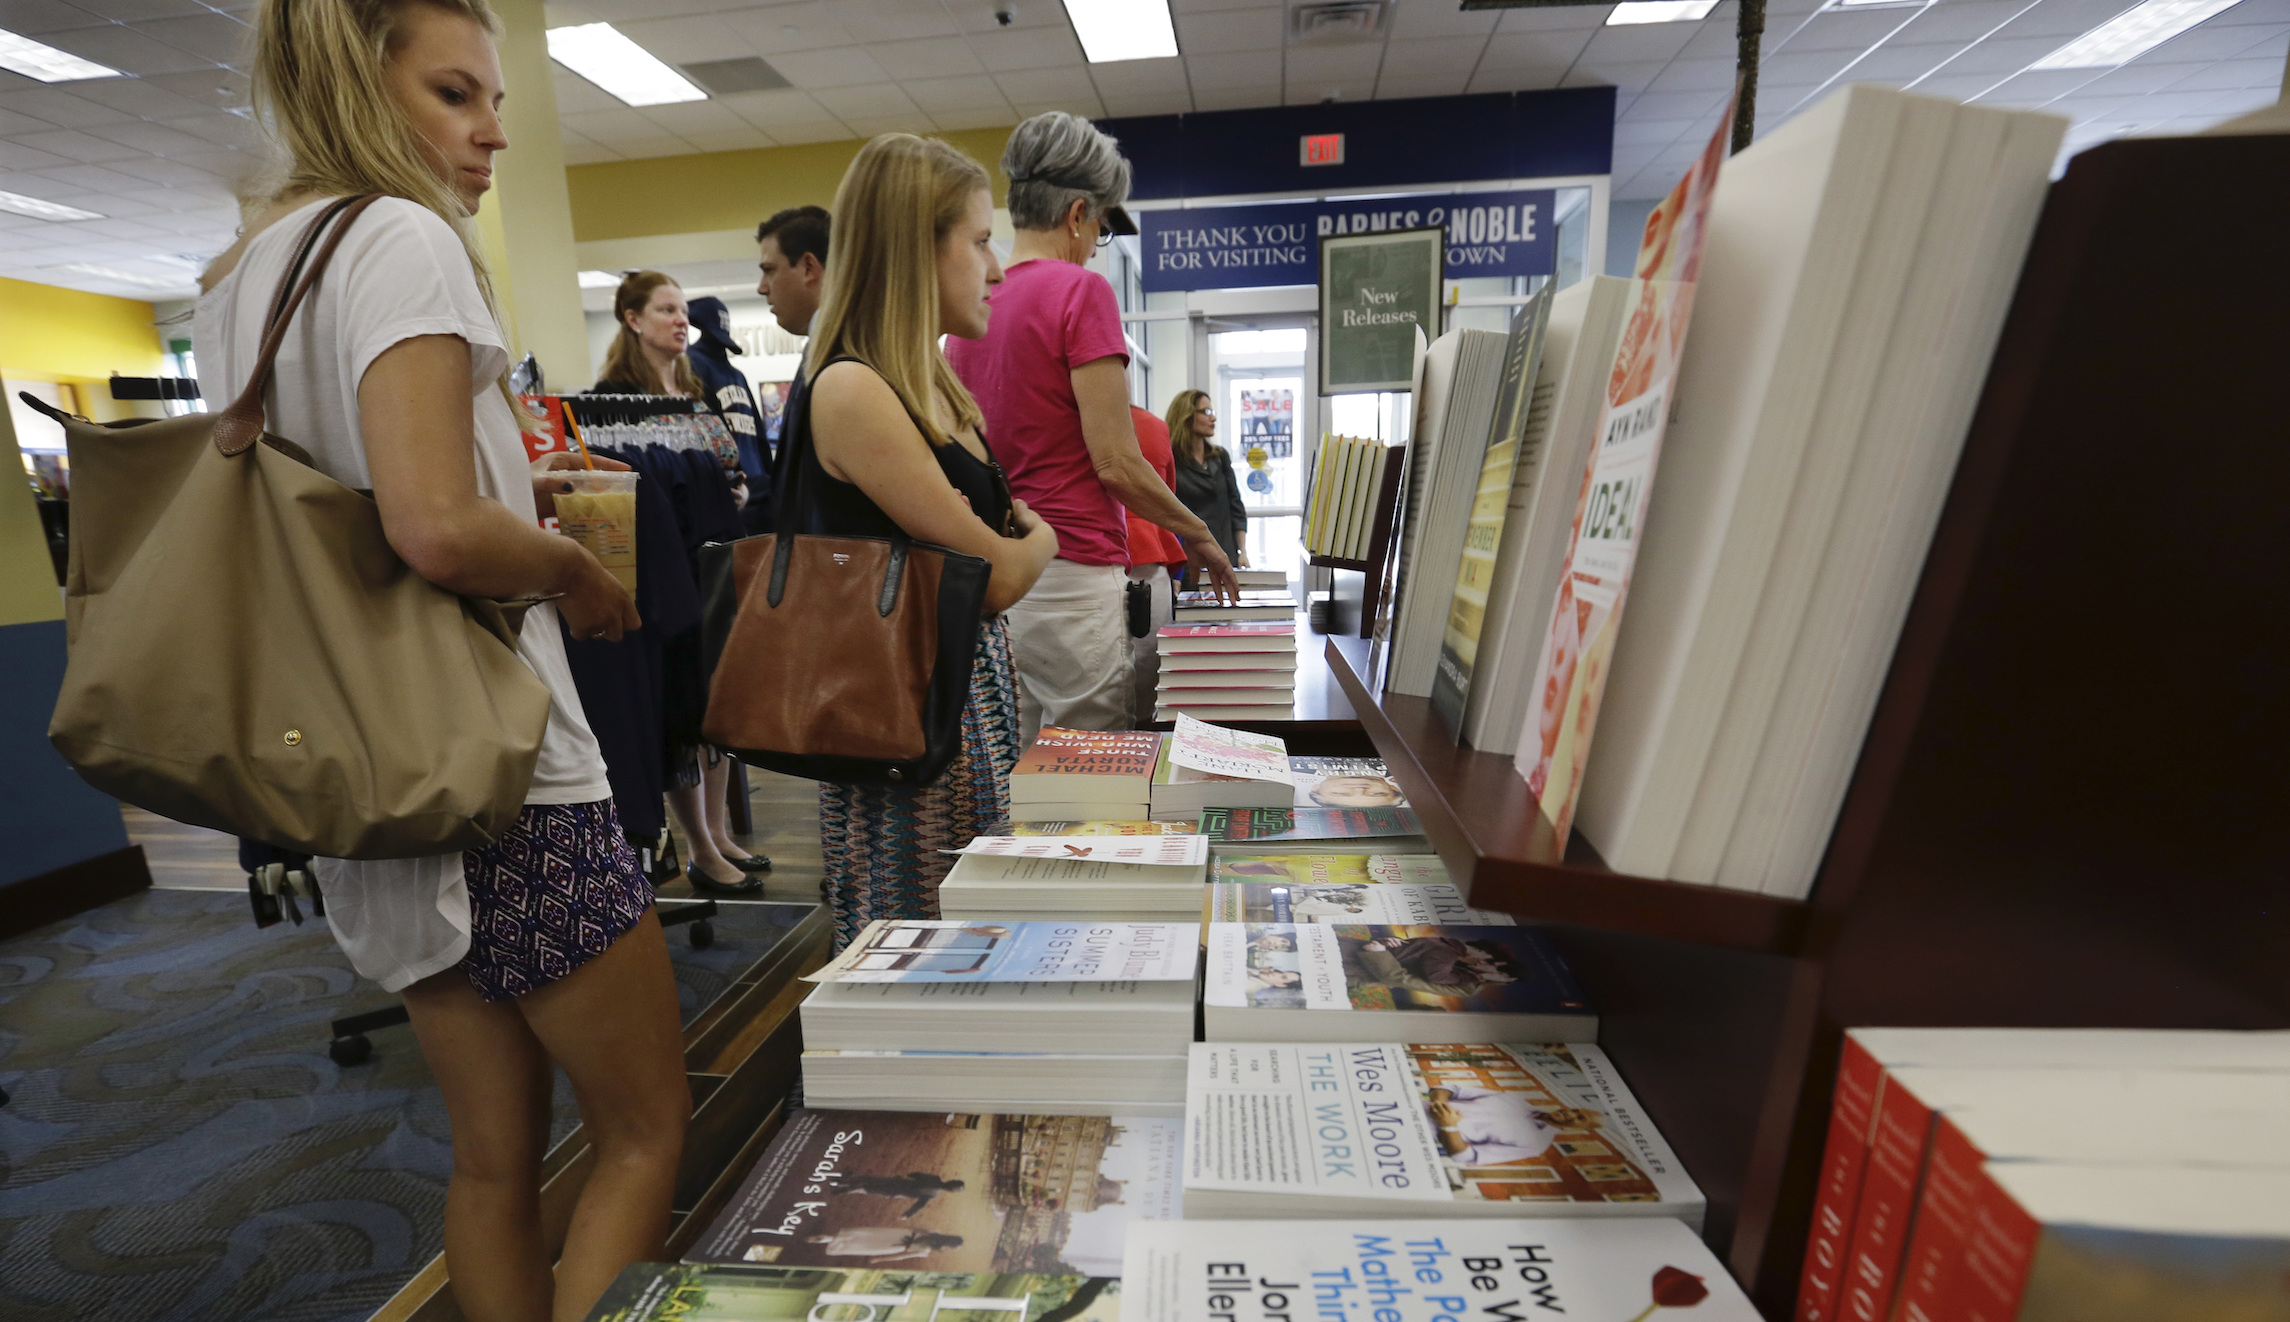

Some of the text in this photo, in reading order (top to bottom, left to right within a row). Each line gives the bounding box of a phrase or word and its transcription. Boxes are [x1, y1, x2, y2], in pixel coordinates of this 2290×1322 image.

[1307, 134, 1340, 163] EXIT
[1157, 223, 1307, 250] THANK YOU
[1451, 204, 1537, 245] NOBLE
[1158, 246, 1307, 271] FOR VISITING
[1446, 245, 1506, 266] OWN
[1360, 287, 1399, 306] New
[1342, 309, 1418, 327] Releases
[1243, 399, 1292, 412] SALE
[1582, 474, 1643, 541] IDEAL
[1036, 738, 1094, 747] WISH
[1077, 748, 1150, 757] THOSE
[1034, 764, 1145, 774] MICHAEL
[1056, 756, 1147, 766] KORYTA
[1029, 927, 1077, 976] SISTERS
[1070, 927, 1113, 976] SUMMER
[1119, 924, 1165, 948] Judy
[1308, 925, 1333, 1002] TESTAMENT YOUTH
[1209, 1051, 1219, 1080] MATTERS
[1268, 1049, 1281, 1084] SEARCHING
[1351, 1047, 1388, 1093] Wes
[1306, 1053, 1357, 1179] THE WORK
[1583, 1056, 1667, 1175] NATIONAL BESTSELLER
[803, 1129, 864, 1194] Sarah's
[1362, 1100, 1411, 1189] Moore
[751, 1201, 828, 1236] Key
[1352, 1234, 1414, 1322] Mathe
[1404, 1237, 1452, 1284] The
[1462, 1256, 1503, 1292] Be
[1507, 1244, 1566, 1313] How
